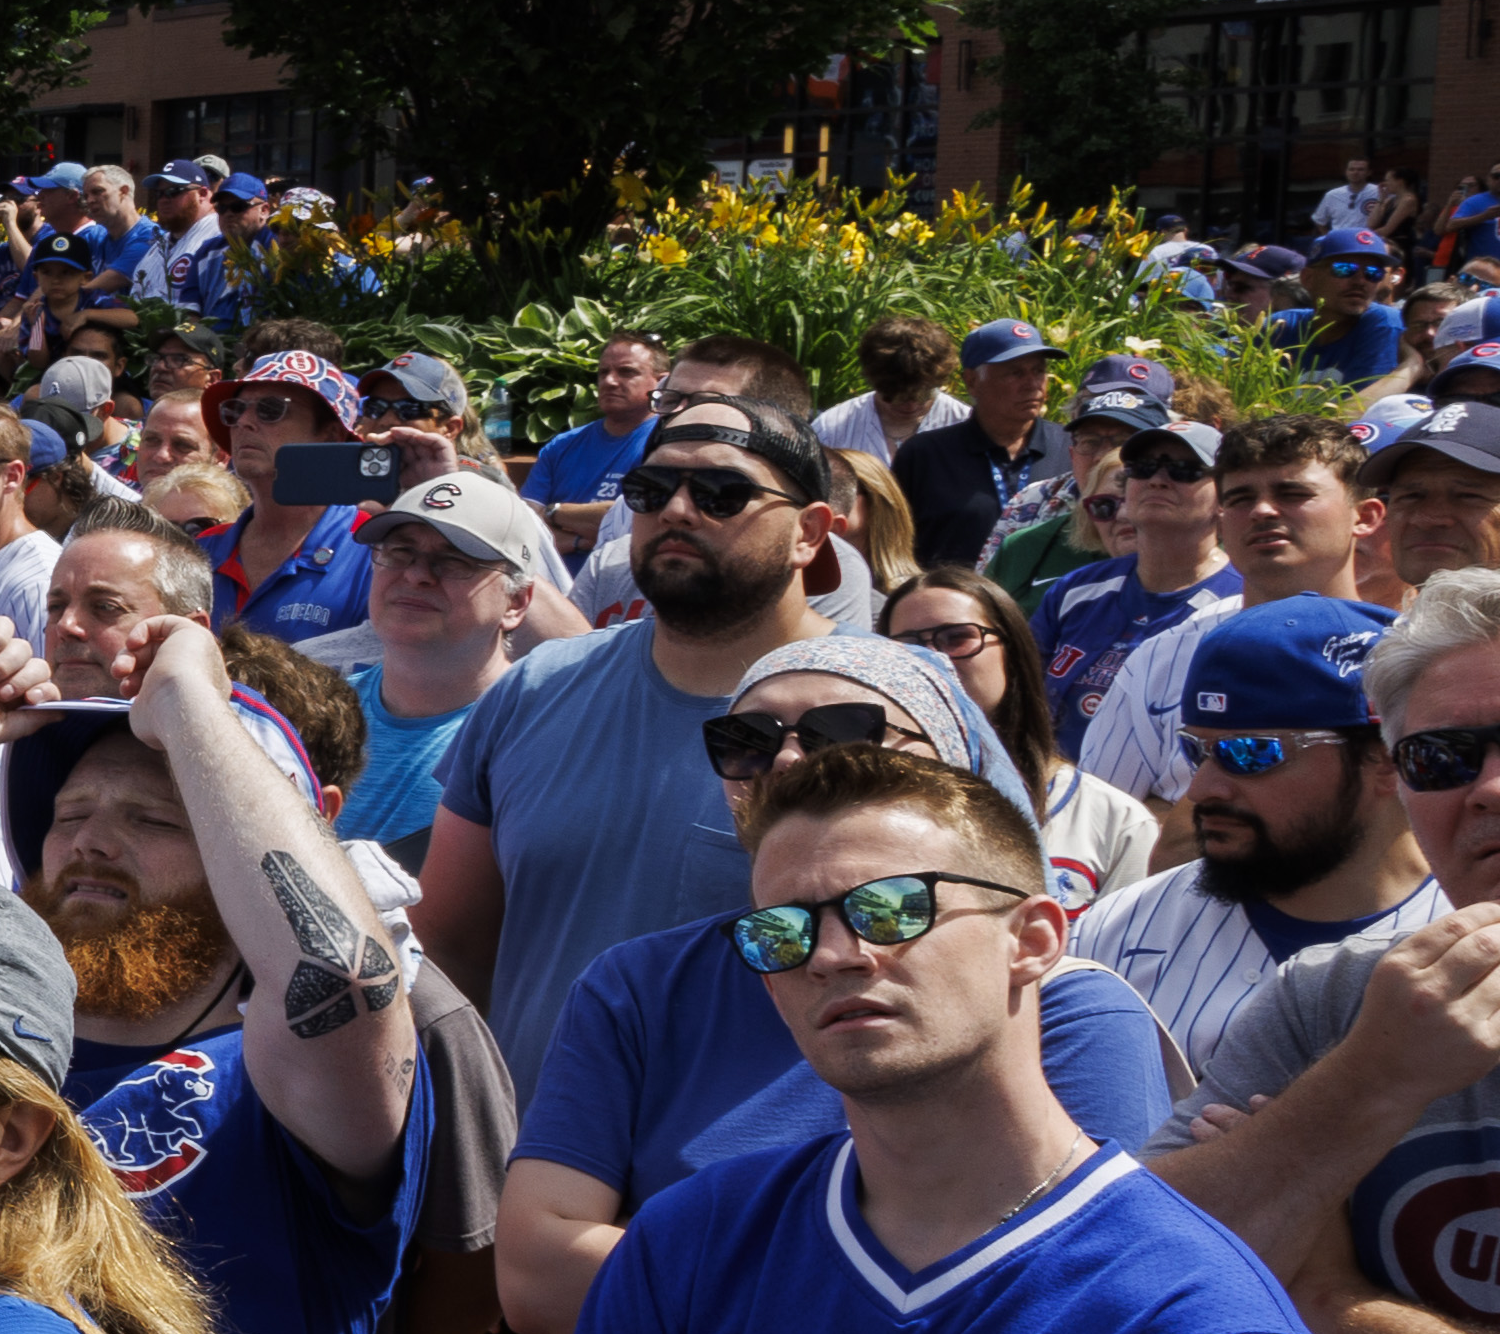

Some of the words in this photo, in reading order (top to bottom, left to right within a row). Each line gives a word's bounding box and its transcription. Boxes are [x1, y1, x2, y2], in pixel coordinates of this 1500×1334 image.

[1012, 322, 1032, 339] C
[423, 482, 462, 510] C
[597, 482, 618, 498] 23
